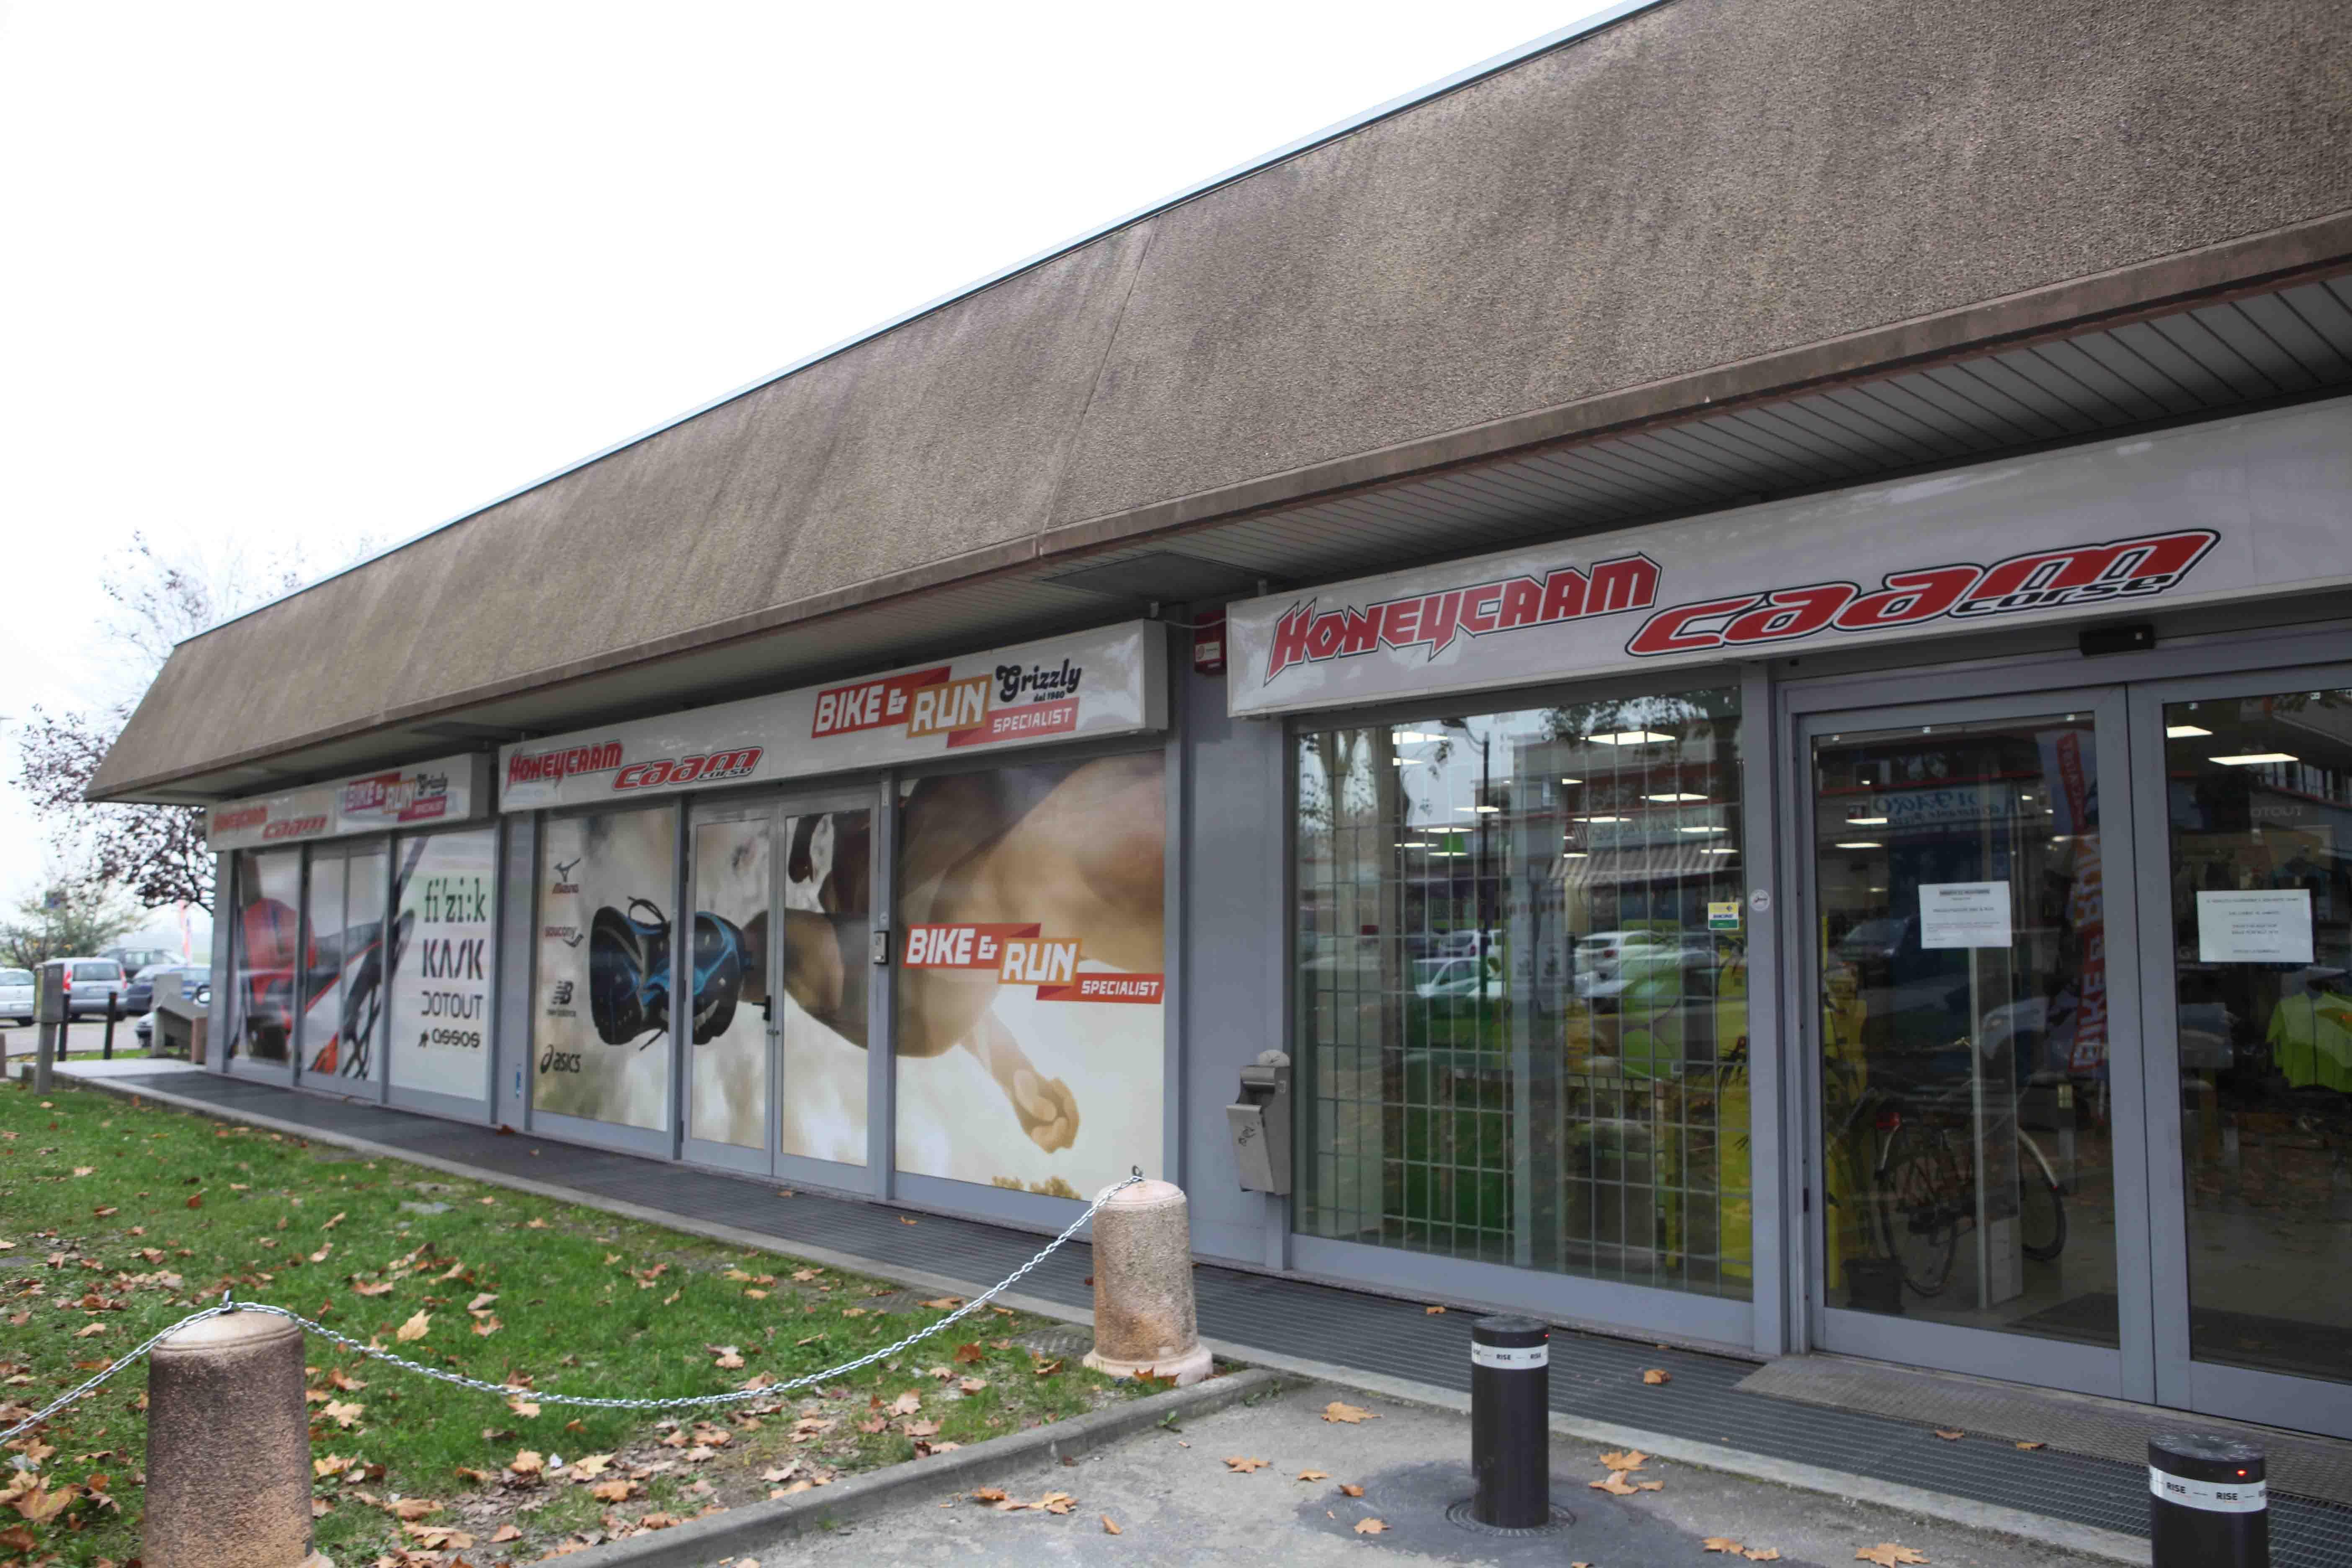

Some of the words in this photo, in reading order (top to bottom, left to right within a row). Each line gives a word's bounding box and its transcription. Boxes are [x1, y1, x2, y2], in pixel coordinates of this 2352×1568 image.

[1625, 529, 2220, 657] caam
[1952, 574, 2177, 613] corse
[1264, 551, 1662, 687] HONEYCAAM
[996, 658, 1082, 703] Grizzly
[815, 685, 885, 732] BIKE
[886, 689, 908, 715] &
[912, 682, 987, 732] RUN
[993, 707, 1072, 733] SPECIALIST
[505, 739, 624, 794] HONEYCAAM
[612, 746, 764, 791] caam
[347, 780, 375, 808] BIKE
[387, 780, 415, 811] RUN
[2250, 805, 2304, 818] OTOUT
[906, 928, 975, 963] BIKE
[978, 936, 998, 959] &
[1002, 943, 1077, 981] RUN
[1081, 980, 1160, 995] SPECIALIST
[421, 991, 483, 1020] DOTOUT
[432, 1029, 480, 1048] assos
[553, 1052, 581, 1073] asics
[2166, 1482, 2186, 1494] RISE
[2216, 1492, 2238, 1501] RISE
